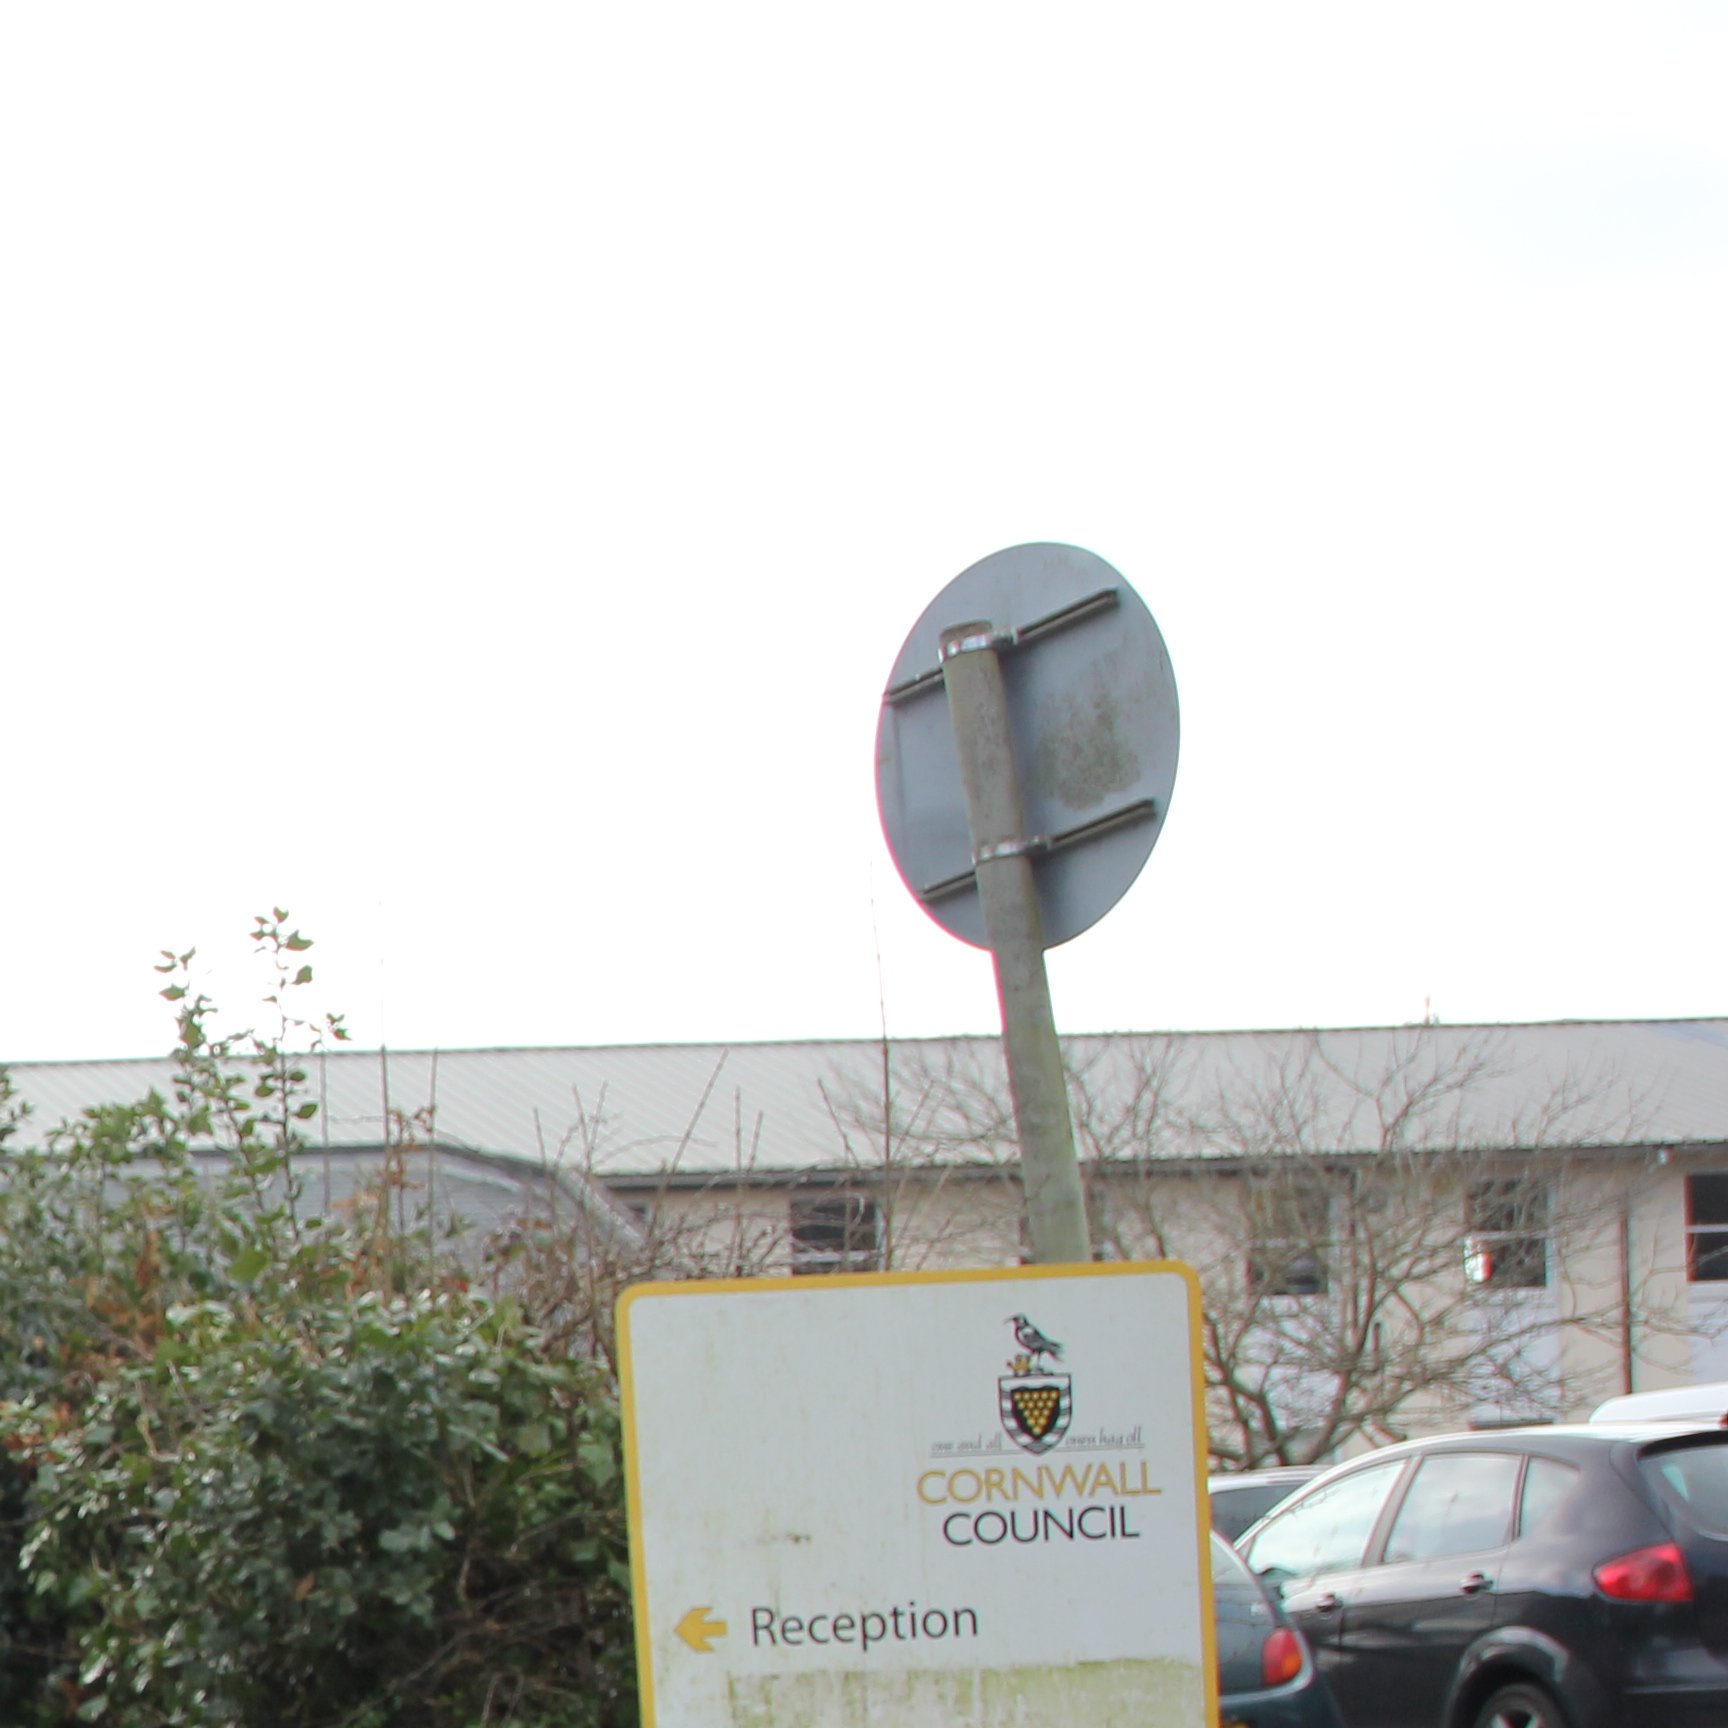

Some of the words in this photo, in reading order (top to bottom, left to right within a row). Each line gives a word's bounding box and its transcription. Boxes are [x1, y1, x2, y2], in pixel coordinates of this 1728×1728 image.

[917, 1460, 1162, 1504] CORNWALL
[943, 1504, 1140, 1545] COUNCIL
[751, 1601, 978, 1651] Reception
